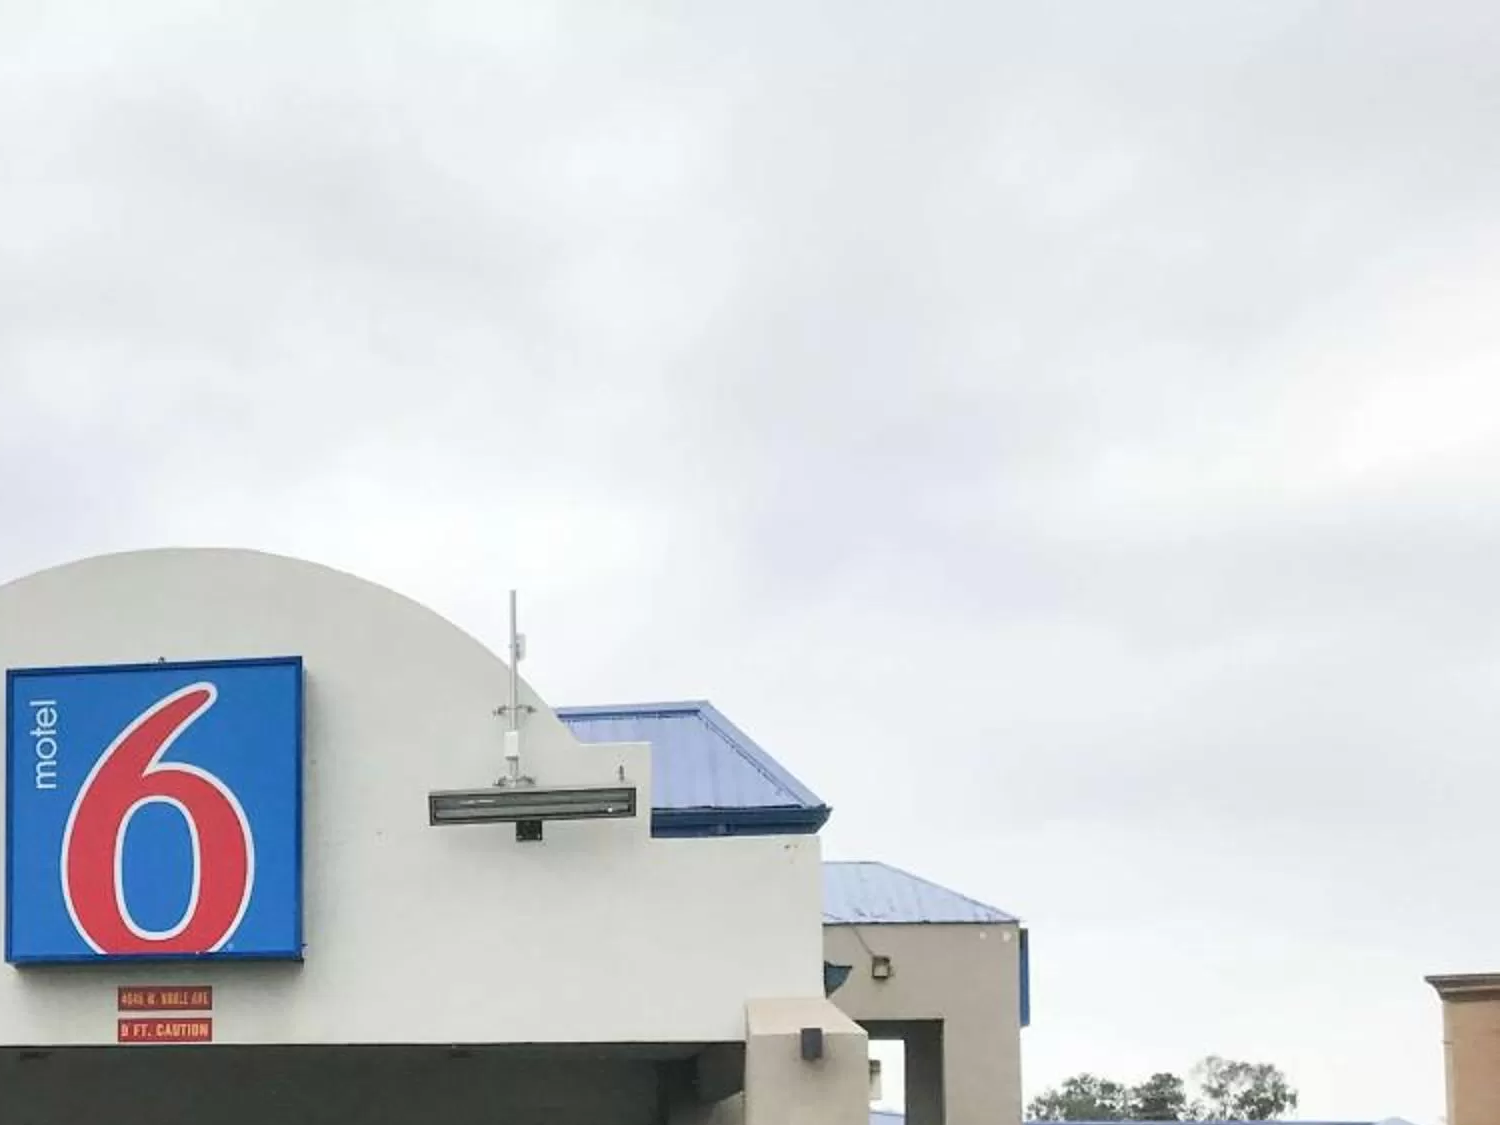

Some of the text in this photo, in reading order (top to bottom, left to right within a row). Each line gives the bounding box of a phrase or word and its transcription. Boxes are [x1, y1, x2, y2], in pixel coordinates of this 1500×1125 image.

[29, 681, 255, 955] motel 6
[133, 1023, 152, 1037] FT.
[156, 1023, 209, 1037] CAUTION
